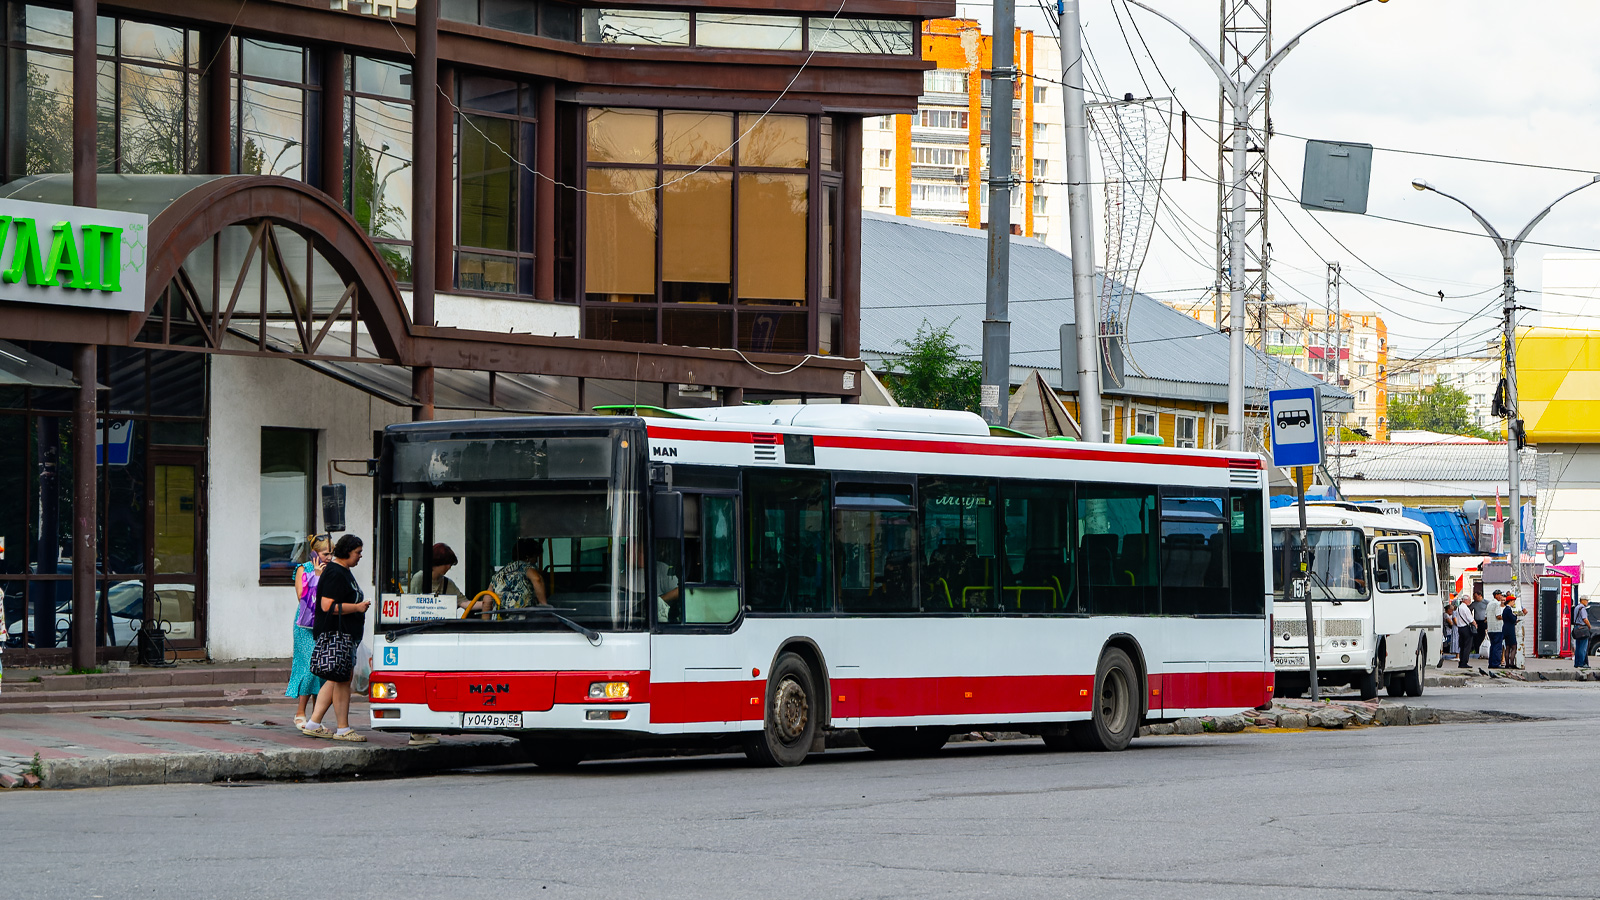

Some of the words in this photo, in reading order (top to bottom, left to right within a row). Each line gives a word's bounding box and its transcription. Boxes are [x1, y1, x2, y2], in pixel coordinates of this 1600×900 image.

[653, 446, 678, 457] MAN
[382, 600, 399, 617] 431
[469, 684, 510, 693] MAN
[468, 714, 506, 726] У049ВХ
